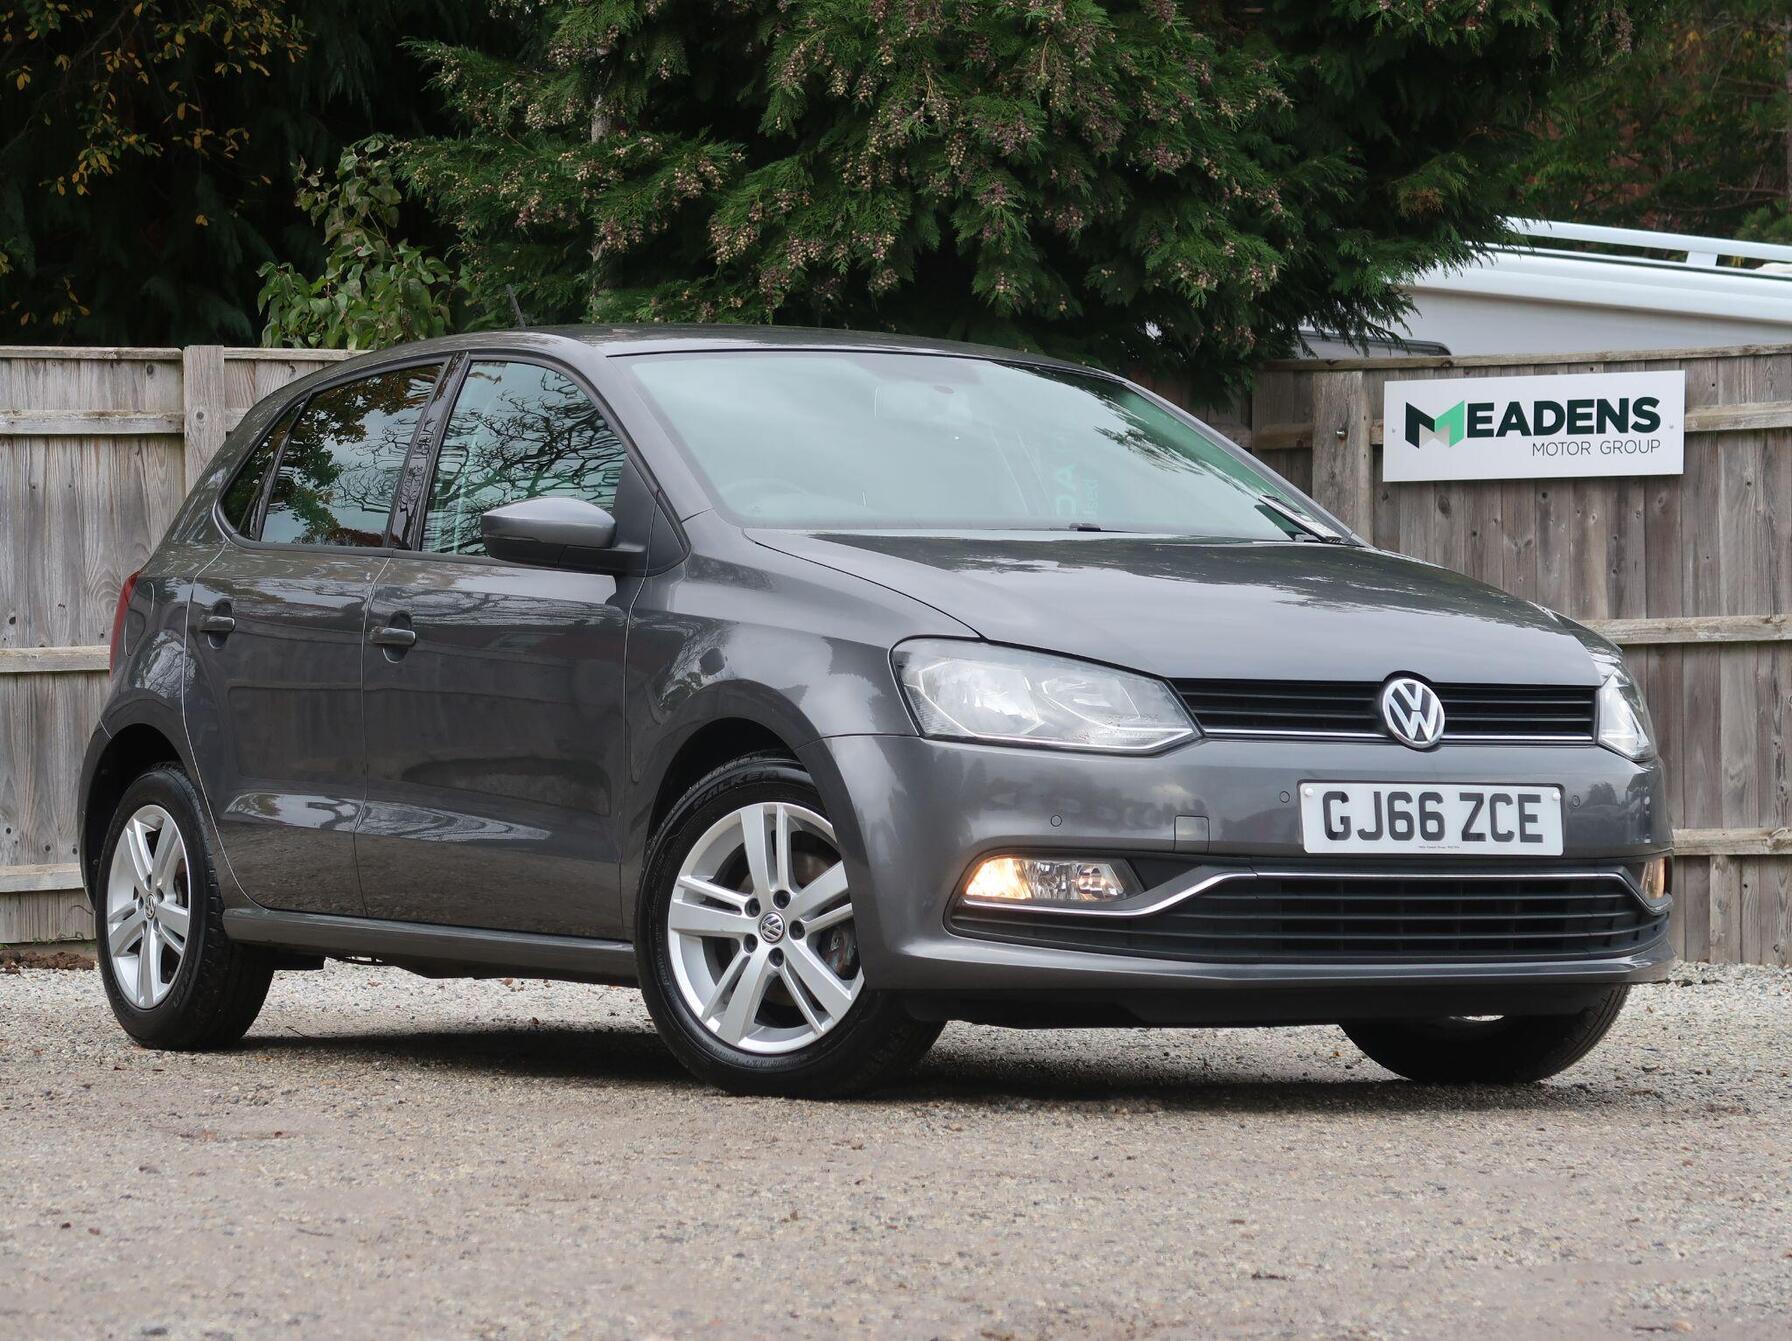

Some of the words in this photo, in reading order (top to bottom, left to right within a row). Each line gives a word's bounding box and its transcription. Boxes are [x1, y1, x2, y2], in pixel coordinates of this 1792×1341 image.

[1405, 396, 1661, 449] MEADENS
[1532, 441, 1592, 457] MOTOR
[1600, 438, 1661, 455] GROUP
[1322, 790, 1446, 842] GJ66
[1458, 791, 1544, 844] ZCE
